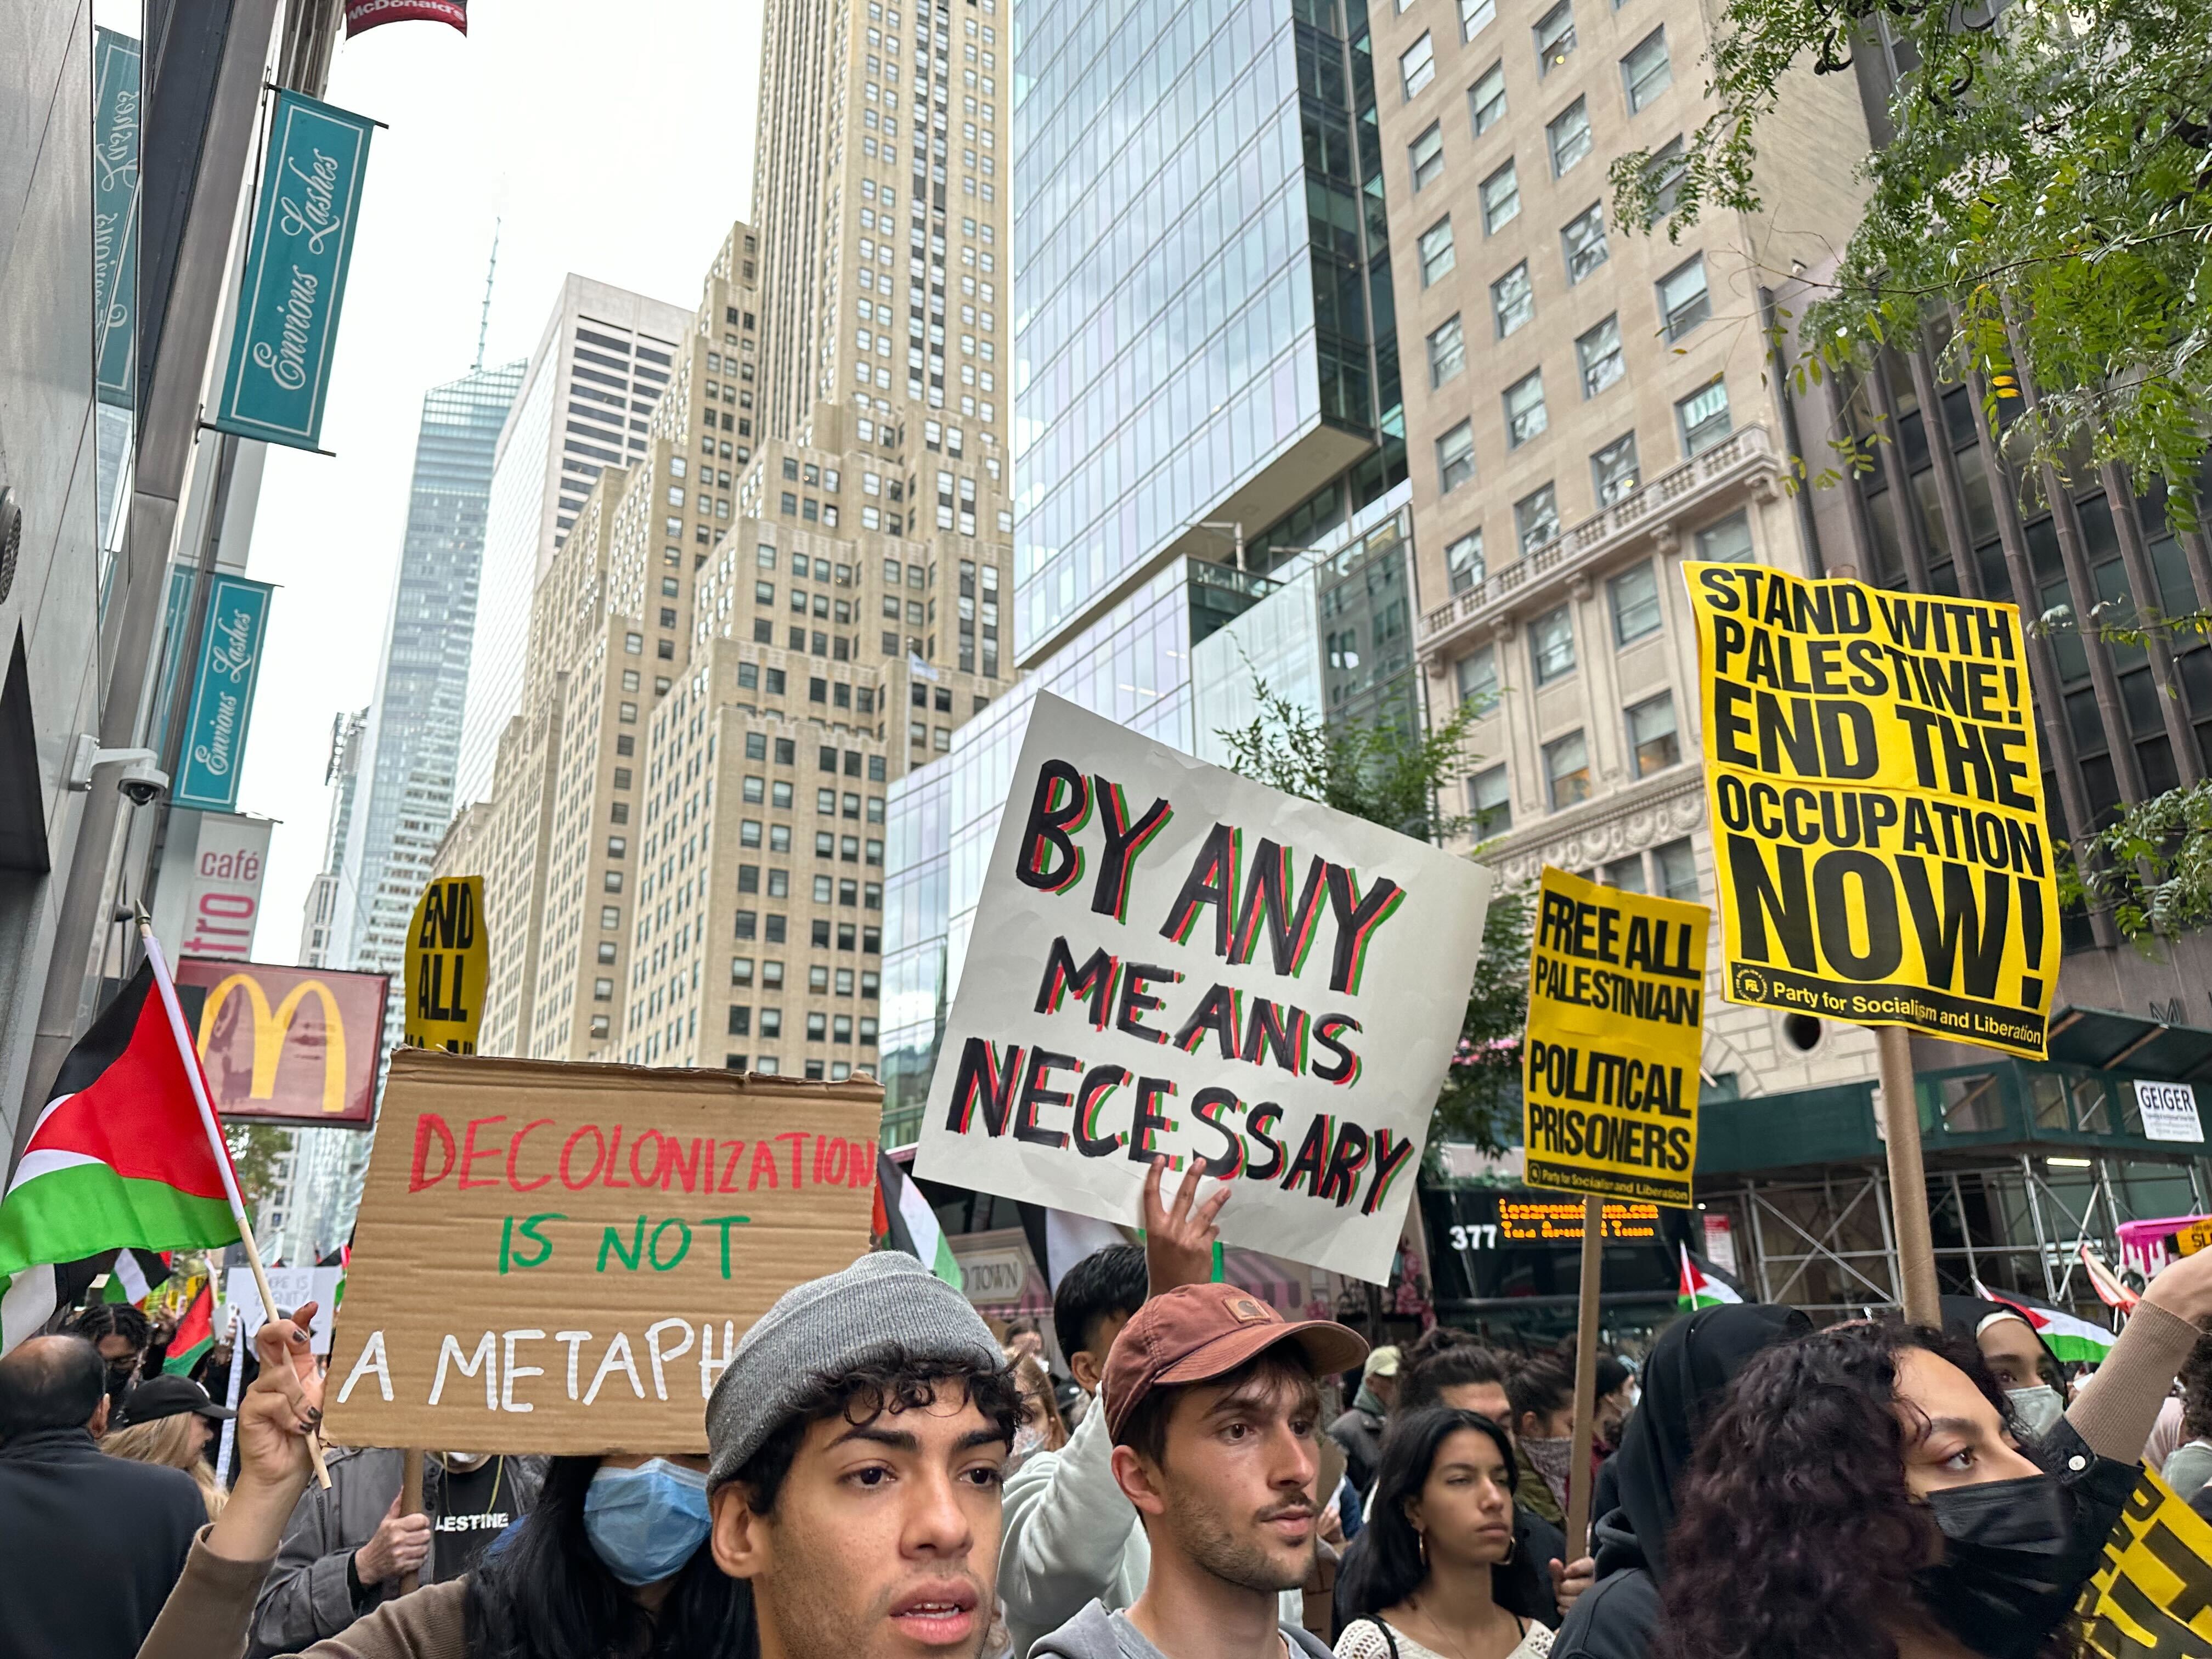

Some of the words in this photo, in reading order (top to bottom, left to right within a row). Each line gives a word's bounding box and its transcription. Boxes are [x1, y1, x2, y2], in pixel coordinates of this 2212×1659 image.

[281, 148, 340, 255] Lashes
[253, 264, 320, 391] Envious
[213, 609, 252, 684] Lashes
[1700, 568, 1871, 635] STAND
[1877, 594, 2015, 661] WITH
[1713, 615, 2022, 724] PALESTINE!
[195, 692, 238, 776] Envious
[1714, 677, 1880, 781] END
[1895, 705, 2036, 812] THE
[201, 849, 259, 881] café
[1717, 775, 2045, 878] OCCUPATION
[419, 883, 473, 949] END
[1015, 759, 1172, 924] BY
[1159, 822, 1407, 996] ANY
[1539, 889, 1621, 964] FREE
[1624, 915, 1701, 980] ALL
[1727, 832, 2044, 1010] NOW!
[418, 954, 467, 1022] ALL
[1034, 936, 1363, 1087] MEANS
[1535, 956, 1700, 1028] PALESTINIAN
[1774, 981, 1818, 1009] Party
[1822, 991, 1847, 1011] for
[1852, 996, 1937, 1022] Socialism
[1940, 1011, 1970, 1028] and
[1975, 1014, 2041, 1045] Liberation
[1529, 1040, 1691, 1119] POLITICAL
[2140, 1085, 2194, 1113] GEIGER
[408, 1113, 877, 1194] DECOLONIZATION
[946, 1036, 1415, 1215] NECESSARY
[1529, 1102, 1690, 1173] PRISONERS
[499, 1212, 568, 1276] IS
[596, 1215, 751, 1280] NOT
[1449, 1224, 1497, 1250] 377
[337, 1330, 394, 1403] A
